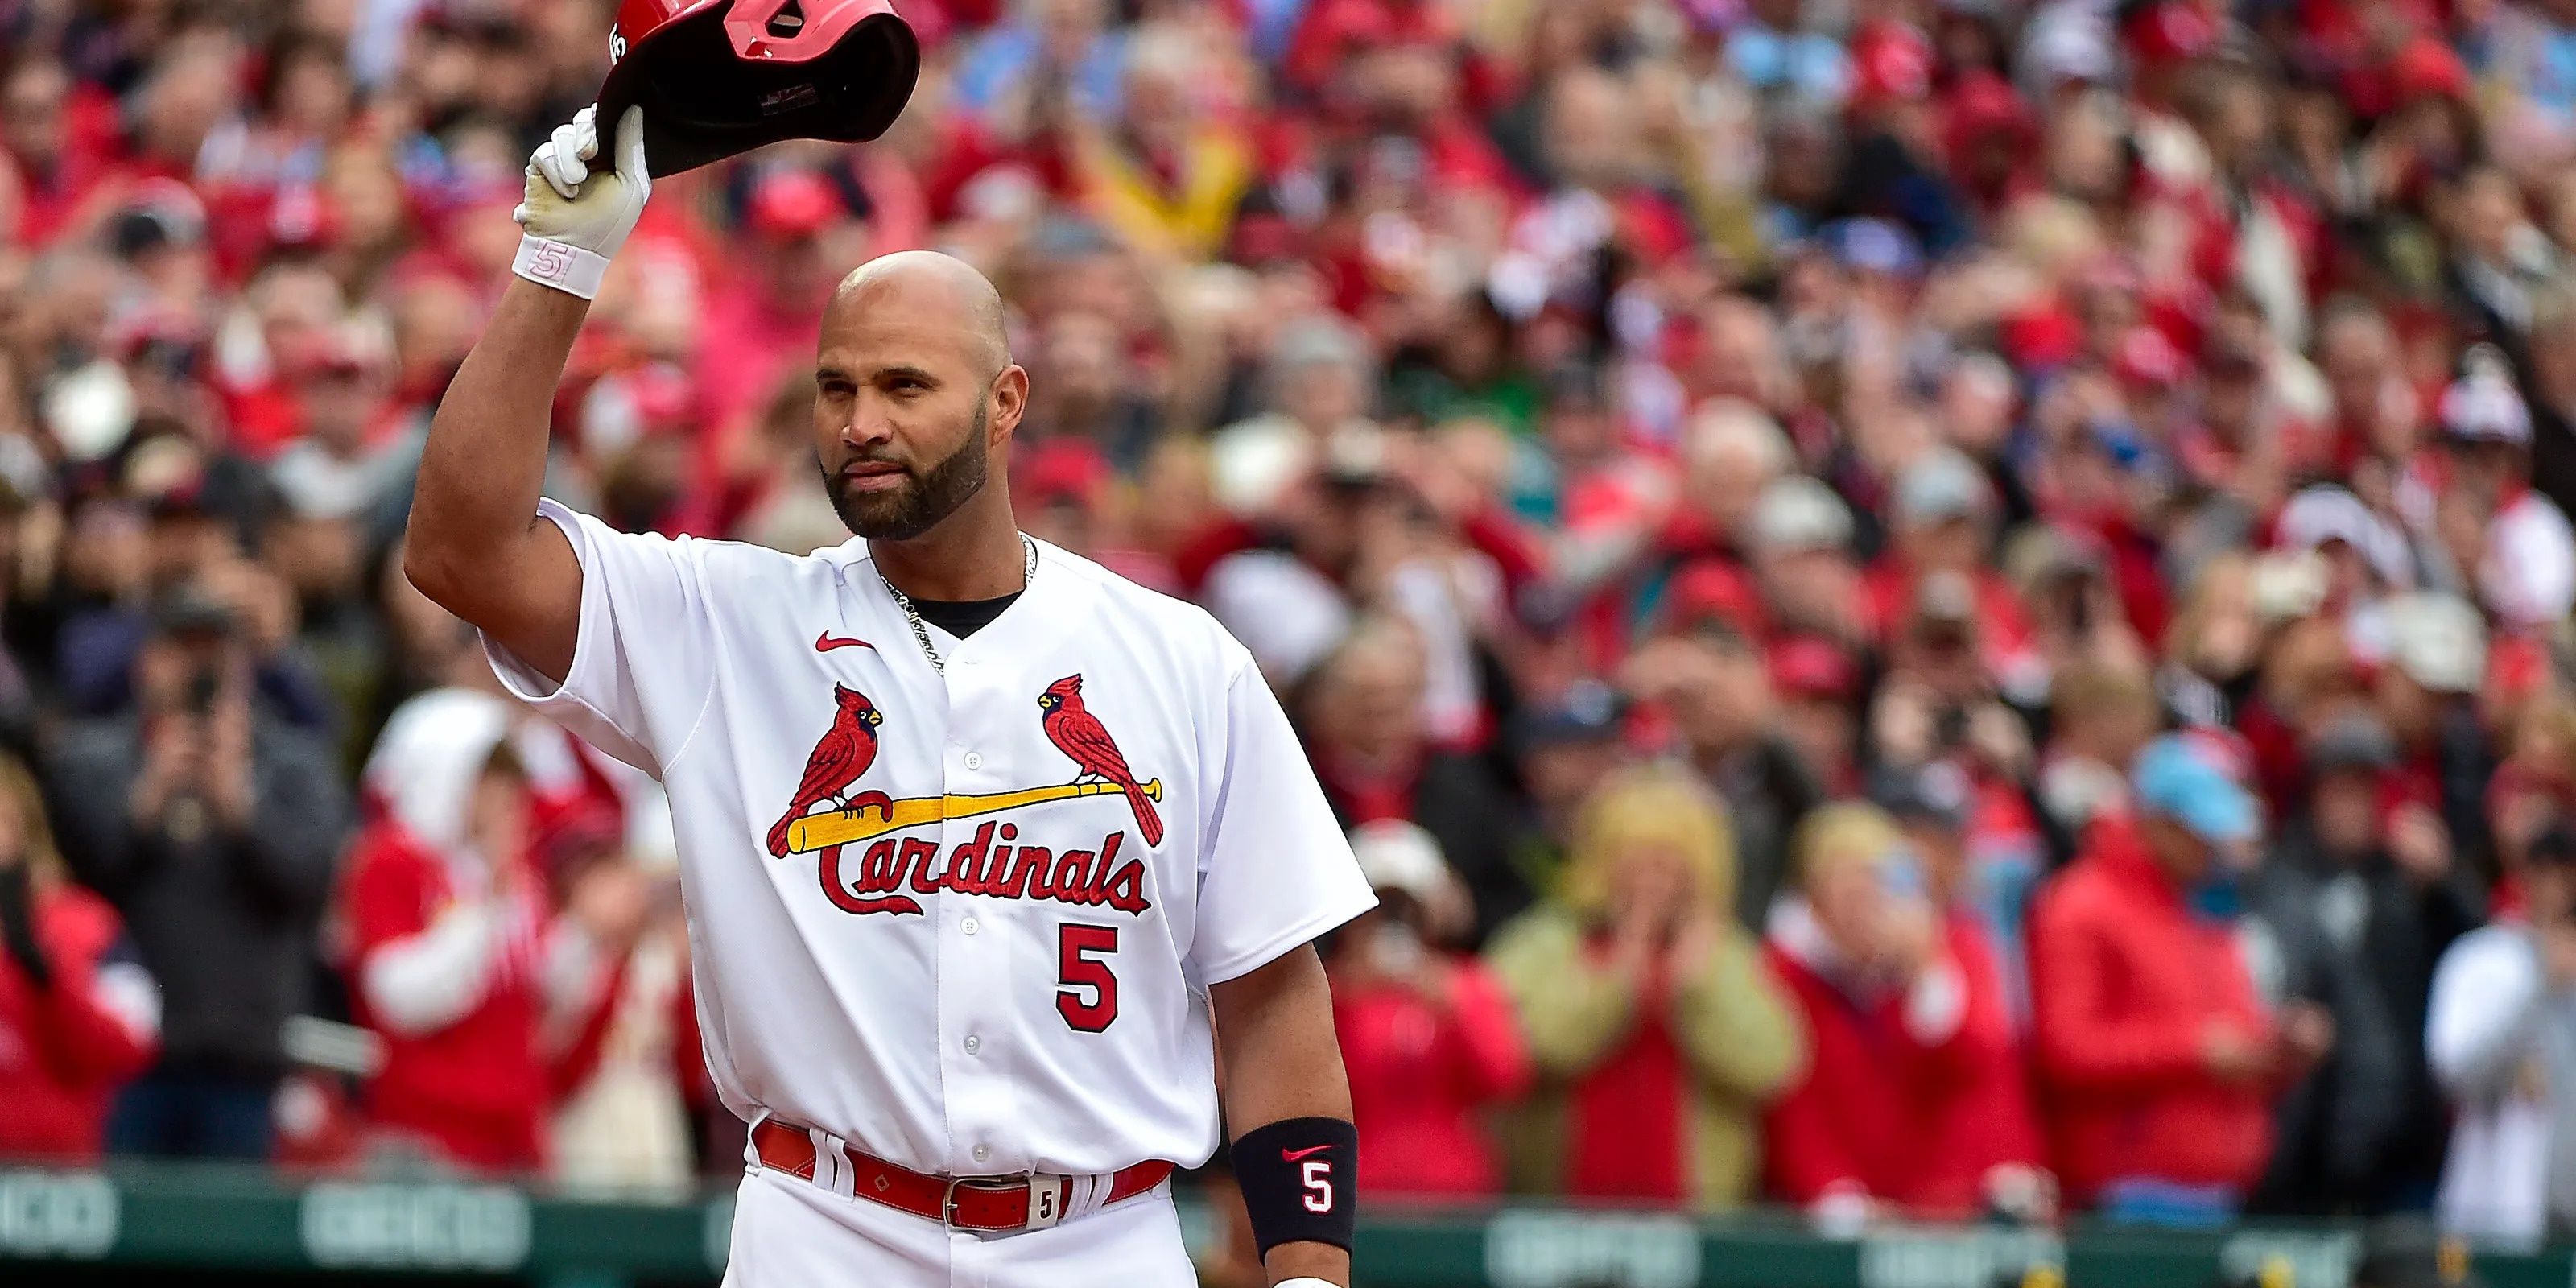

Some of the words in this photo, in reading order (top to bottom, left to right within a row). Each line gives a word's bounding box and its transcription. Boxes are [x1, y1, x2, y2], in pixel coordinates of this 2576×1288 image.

[526, 242, 568, 279] 5
[818, 821, 1151, 917] Cardinals
[1055, 923, 1118, 1033] 5
[1040, 1190, 1053, 1219] 5
[1301, 1161, 1333, 1215] 5
